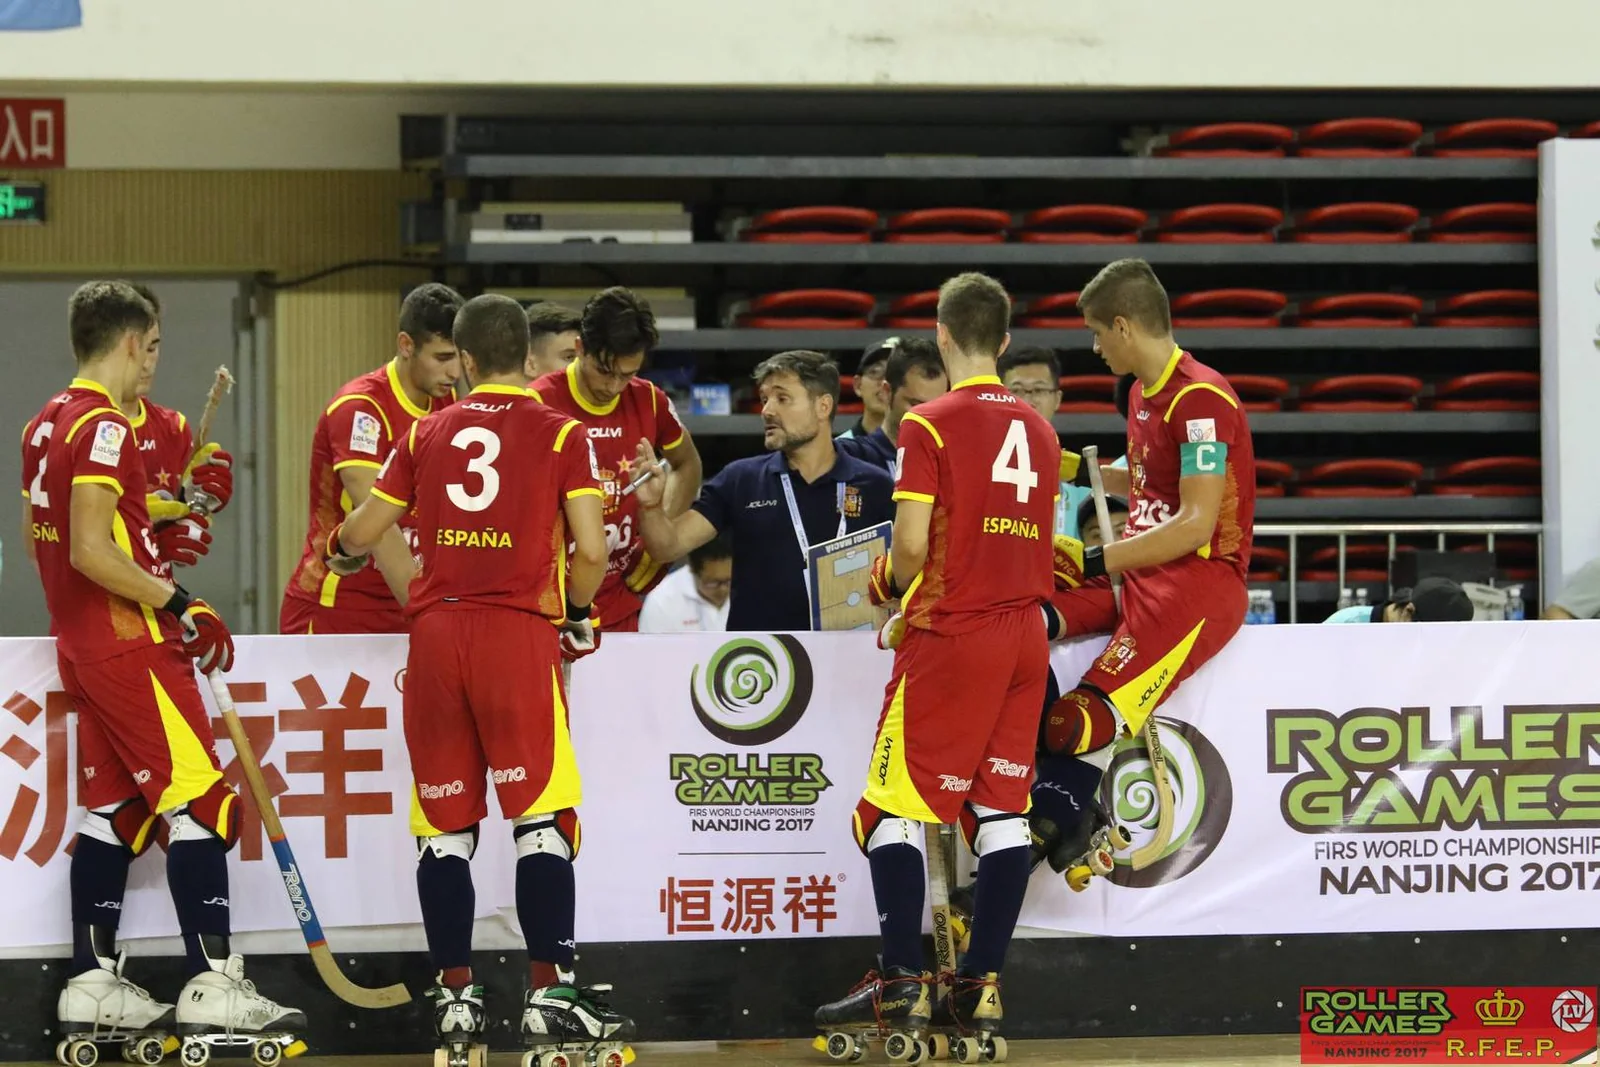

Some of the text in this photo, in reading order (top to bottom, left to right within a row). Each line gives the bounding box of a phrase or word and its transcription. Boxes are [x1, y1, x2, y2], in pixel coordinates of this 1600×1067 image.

[1, 104, 54, 162] 入口
[94, 444, 120, 457] LaLiga
[992, 419, 1038, 503] 4
[1196, 444, 1216, 471] C
[446, 426, 500, 512] 3
[436, 527, 512, 548] ESPAÑA
[983, 517, 1039, 540] ESPAÑA
[491, 766, 526, 785] eno
[670, 753, 828, 785] ROLLER
[987, 757, 1031, 779] Ren
[419, 780, 464, 799] Reno
[675, 780, 820, 806] GAMES
[937, 774, 973, 792] Ren
[689, 808, 816, 817] FIRS WORLD CHAMPIONSHIPS
[1280, 768, 1600, 833] GAMES
[692, 819, 814, 832] NANJING 2017
[1314, 836, 1600, 860] FIRS WORLD CHAMPIONSHI
[1319, 863, 1509, 895] NANJING
[281, 863, 312, 922] Reno
[660, 874, 838, 935] 恒源祥
[986, 993, 997, 1006] 4
